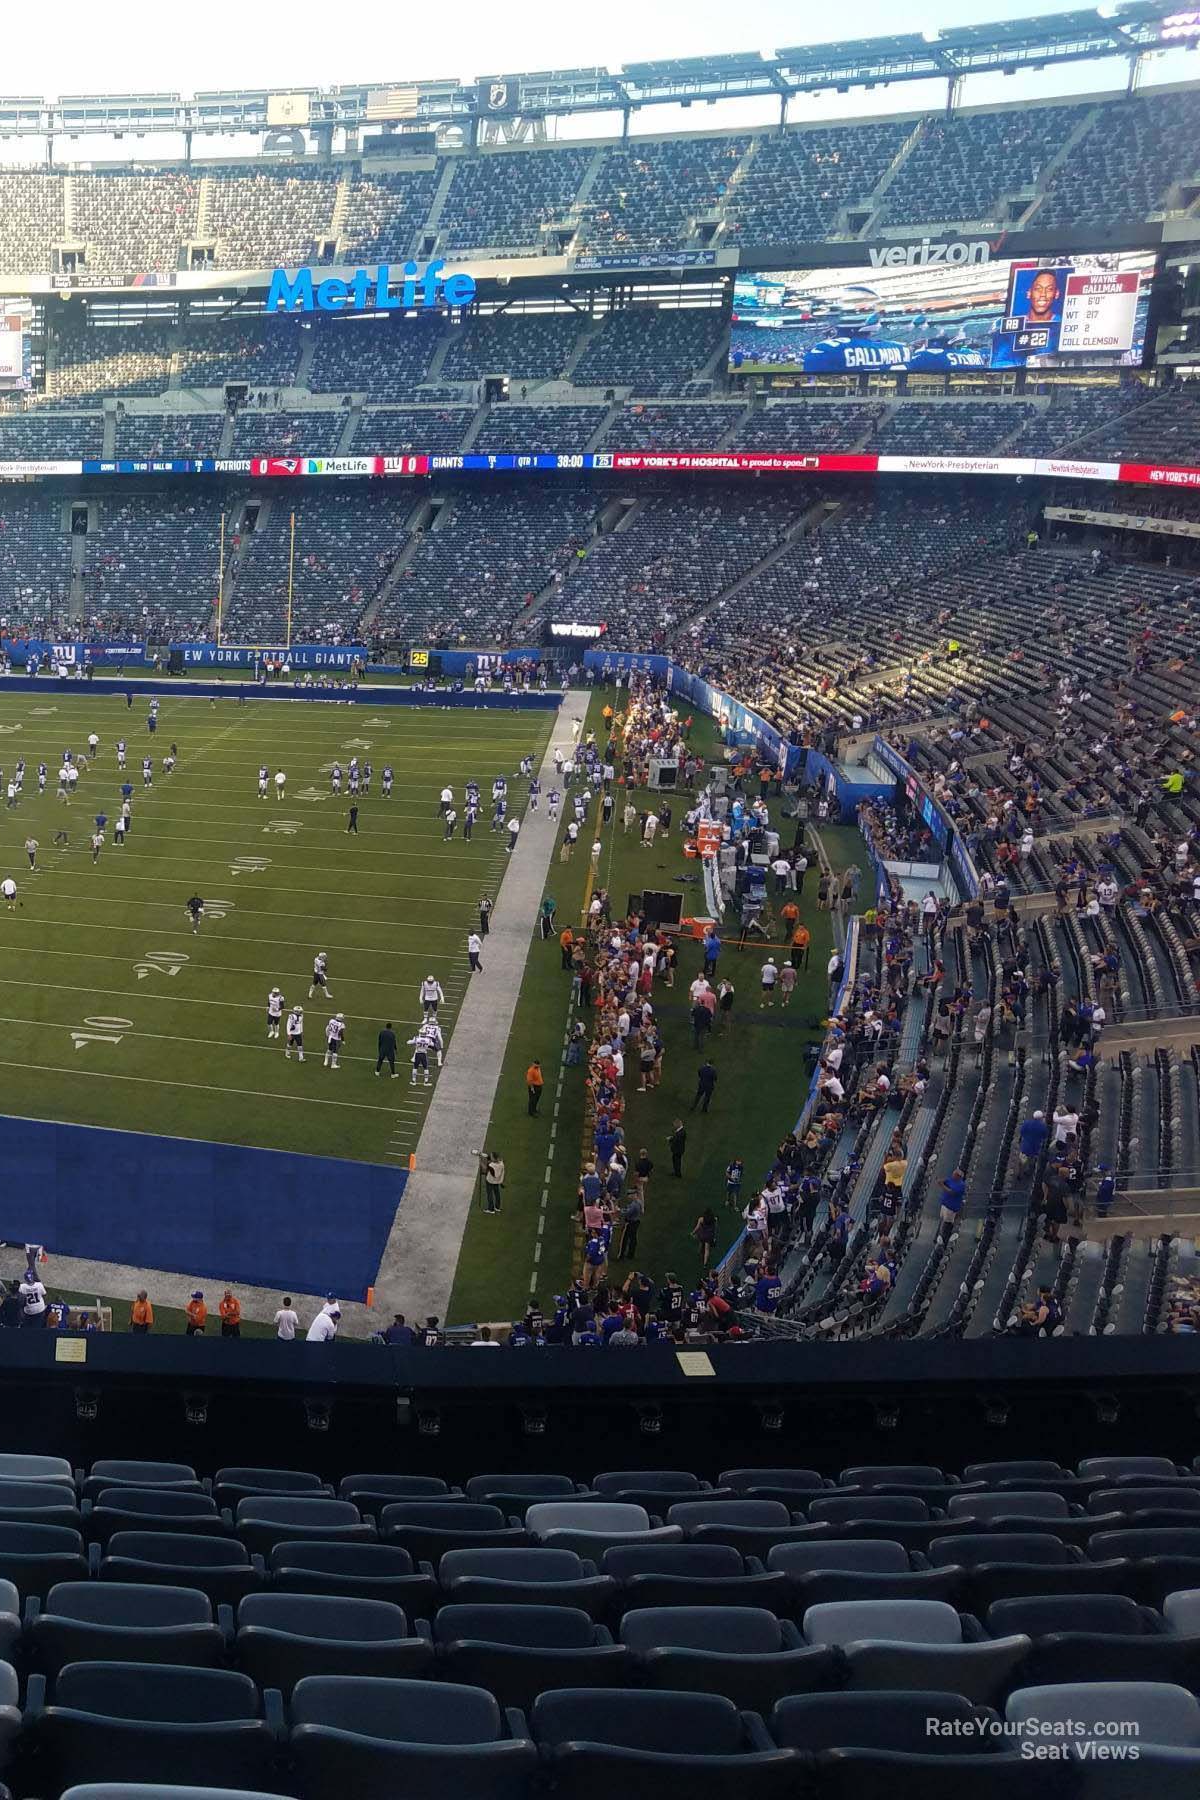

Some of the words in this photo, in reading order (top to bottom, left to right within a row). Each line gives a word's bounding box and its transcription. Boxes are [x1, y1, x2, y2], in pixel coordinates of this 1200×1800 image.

[869, 238, 990, 268] verizon
[266, 259, 476, 311] MetLife
[1090, 275, 1118, 284] WAYNE
[1082, 284, 1123, 294] GALLMAN
[1067, 298, 1077, 306] HT
[1066, 311, 1080, 319] WT
[1086, 311, 1099, 319] 217
[1006, 319, 1019, 329] RB
[1082, 337, 1119, 346] CLEMSON
[844, 348, 900, 367] GALLMAN
[215, 460, 250, 471] PATRIOTS
[326, 461, 368, 471] MetLife
[408, 457, 416, 472] 0
[432, 457, 464, 468] GIANTS
[517, 457, 532, 467] QTR
[598, 456, 609, 466] 25
[618, 458, 640, 467] NEW
[643, 458, 678, 467] YORK'S
[679, 458, 690, 466] #1
[691, 458, 740, 467] HOSPITAL
[750, 458, 772, 469] proud
[773, 458, 782, 466] to
[909, 459, 999, 471] NewYork-Presbyterian
[260, 460, 268, 474] 0
[1150, 471, 1165, 481] NEW
[1166, 471, 1188, 483] YORK'S
[551, 623, 600, 637] verizon
[184, 650, 201, 661] EW
[210, 650, 241, 662] YORK
[315, 653, 360, 665] GIANTS
[413, 653, 427, 664] 25
[1103, 888, 1112, 896] 13
[132, 952, 190, 977] 20
[71, 1016, 134, 1047] 10
[26, 1293, 40, 1304] 21
